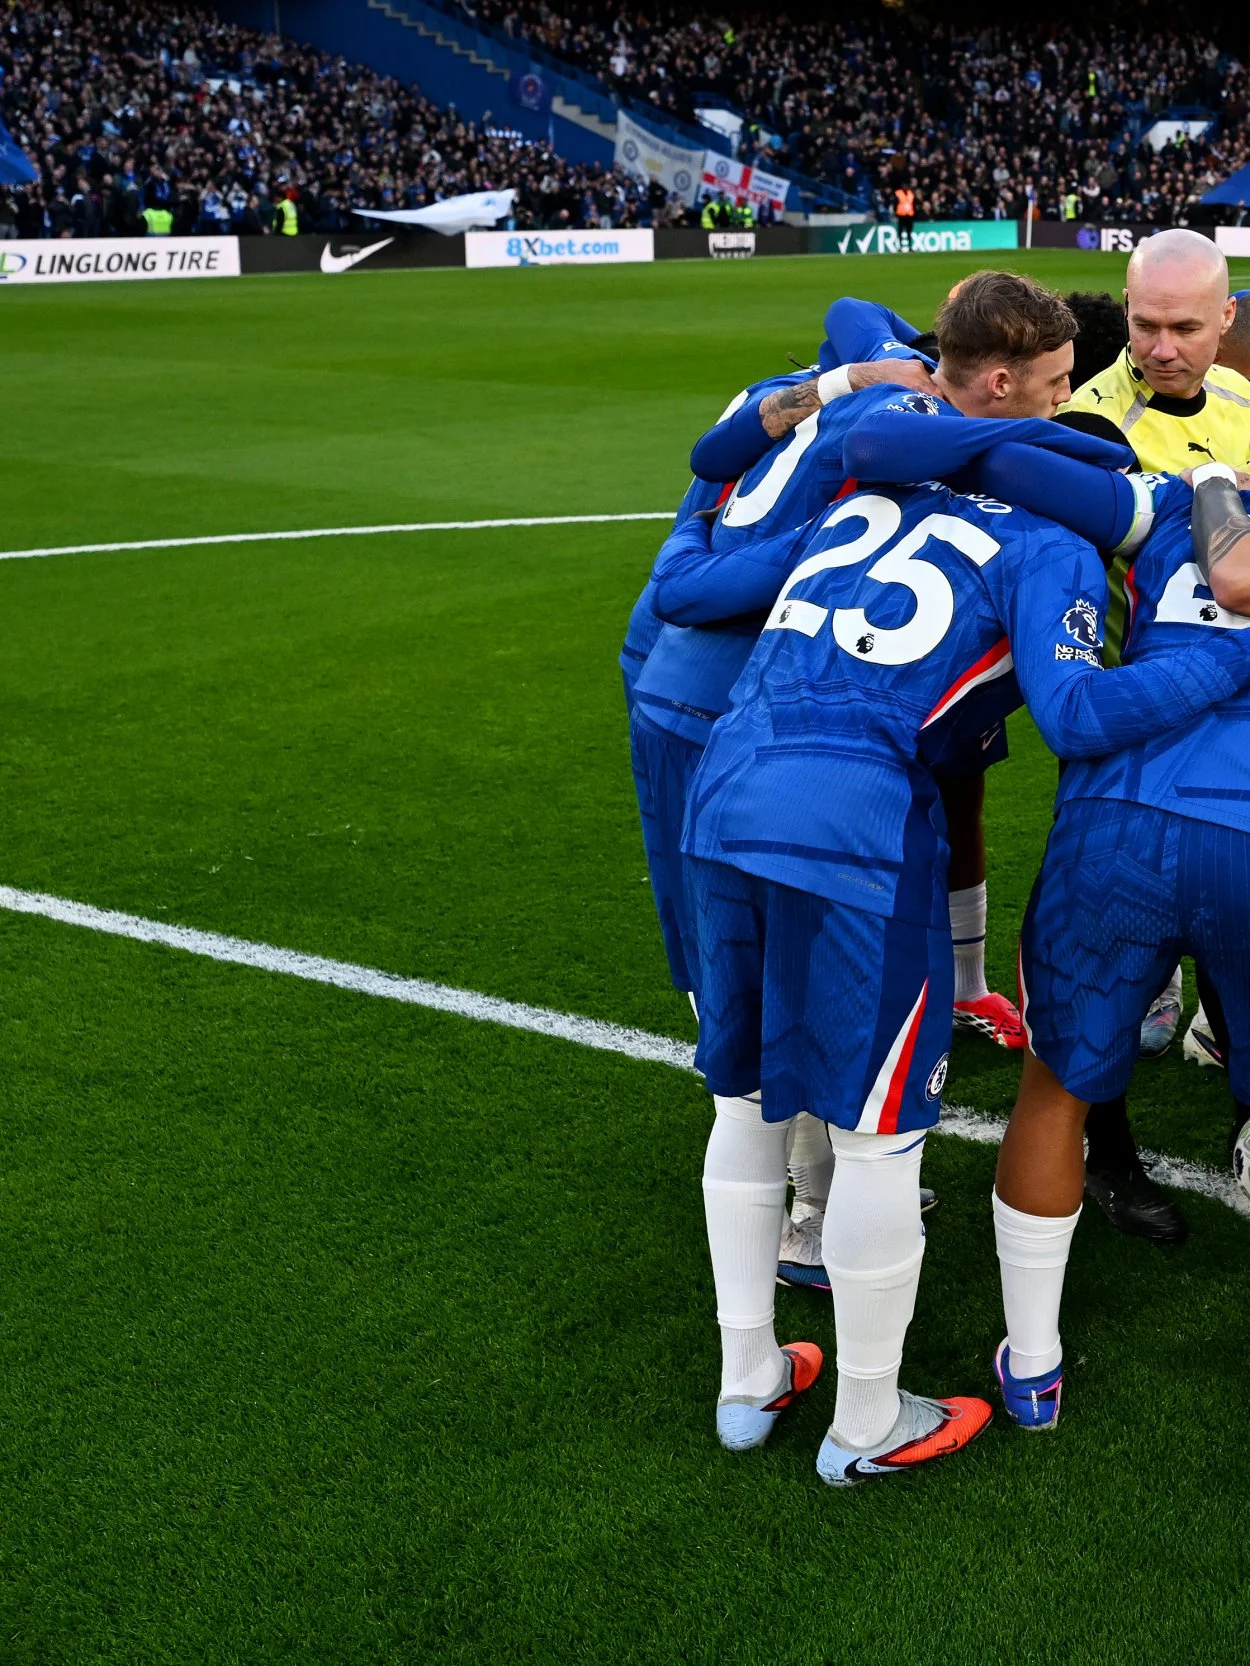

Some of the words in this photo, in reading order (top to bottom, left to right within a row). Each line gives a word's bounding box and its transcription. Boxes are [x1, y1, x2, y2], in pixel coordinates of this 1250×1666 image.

[506, 237, 620, 258] 8Xbet.com
[35, 252, 158, 276] LINGLONG
[166, 250, 220, 270] TIRE
[761, 494, 1003, 667] 25
[1055, 643, 1074, 654] No
